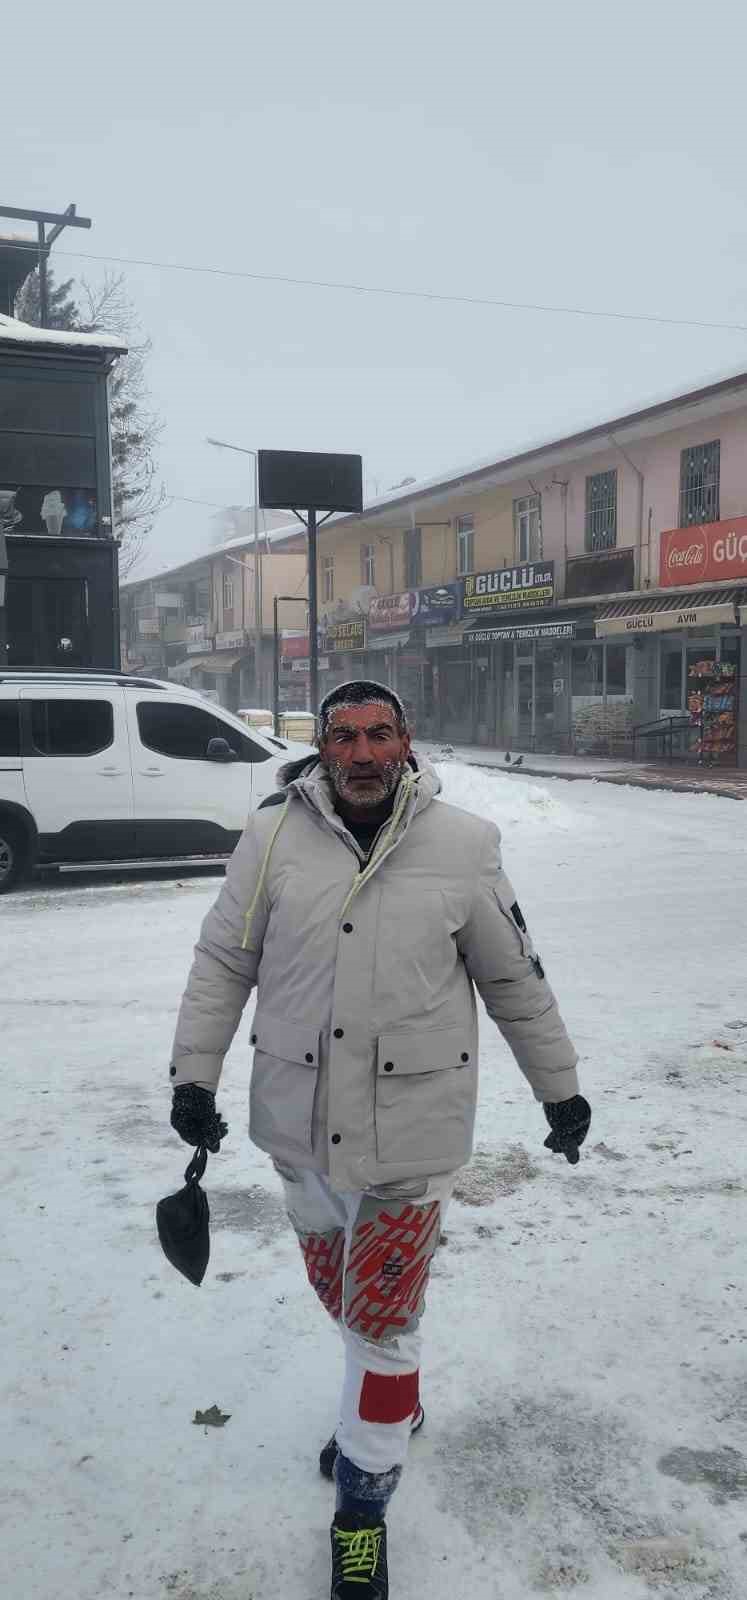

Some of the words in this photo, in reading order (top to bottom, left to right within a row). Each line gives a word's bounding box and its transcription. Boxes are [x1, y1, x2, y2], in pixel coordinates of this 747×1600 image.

[668, 543, 705, 568] Coca-Cola
[713, 532, 747, 563] GÜÇ
[475, 567, 534, 595] GÜÇLÜ
[677, 613, 697, 624] AVM
